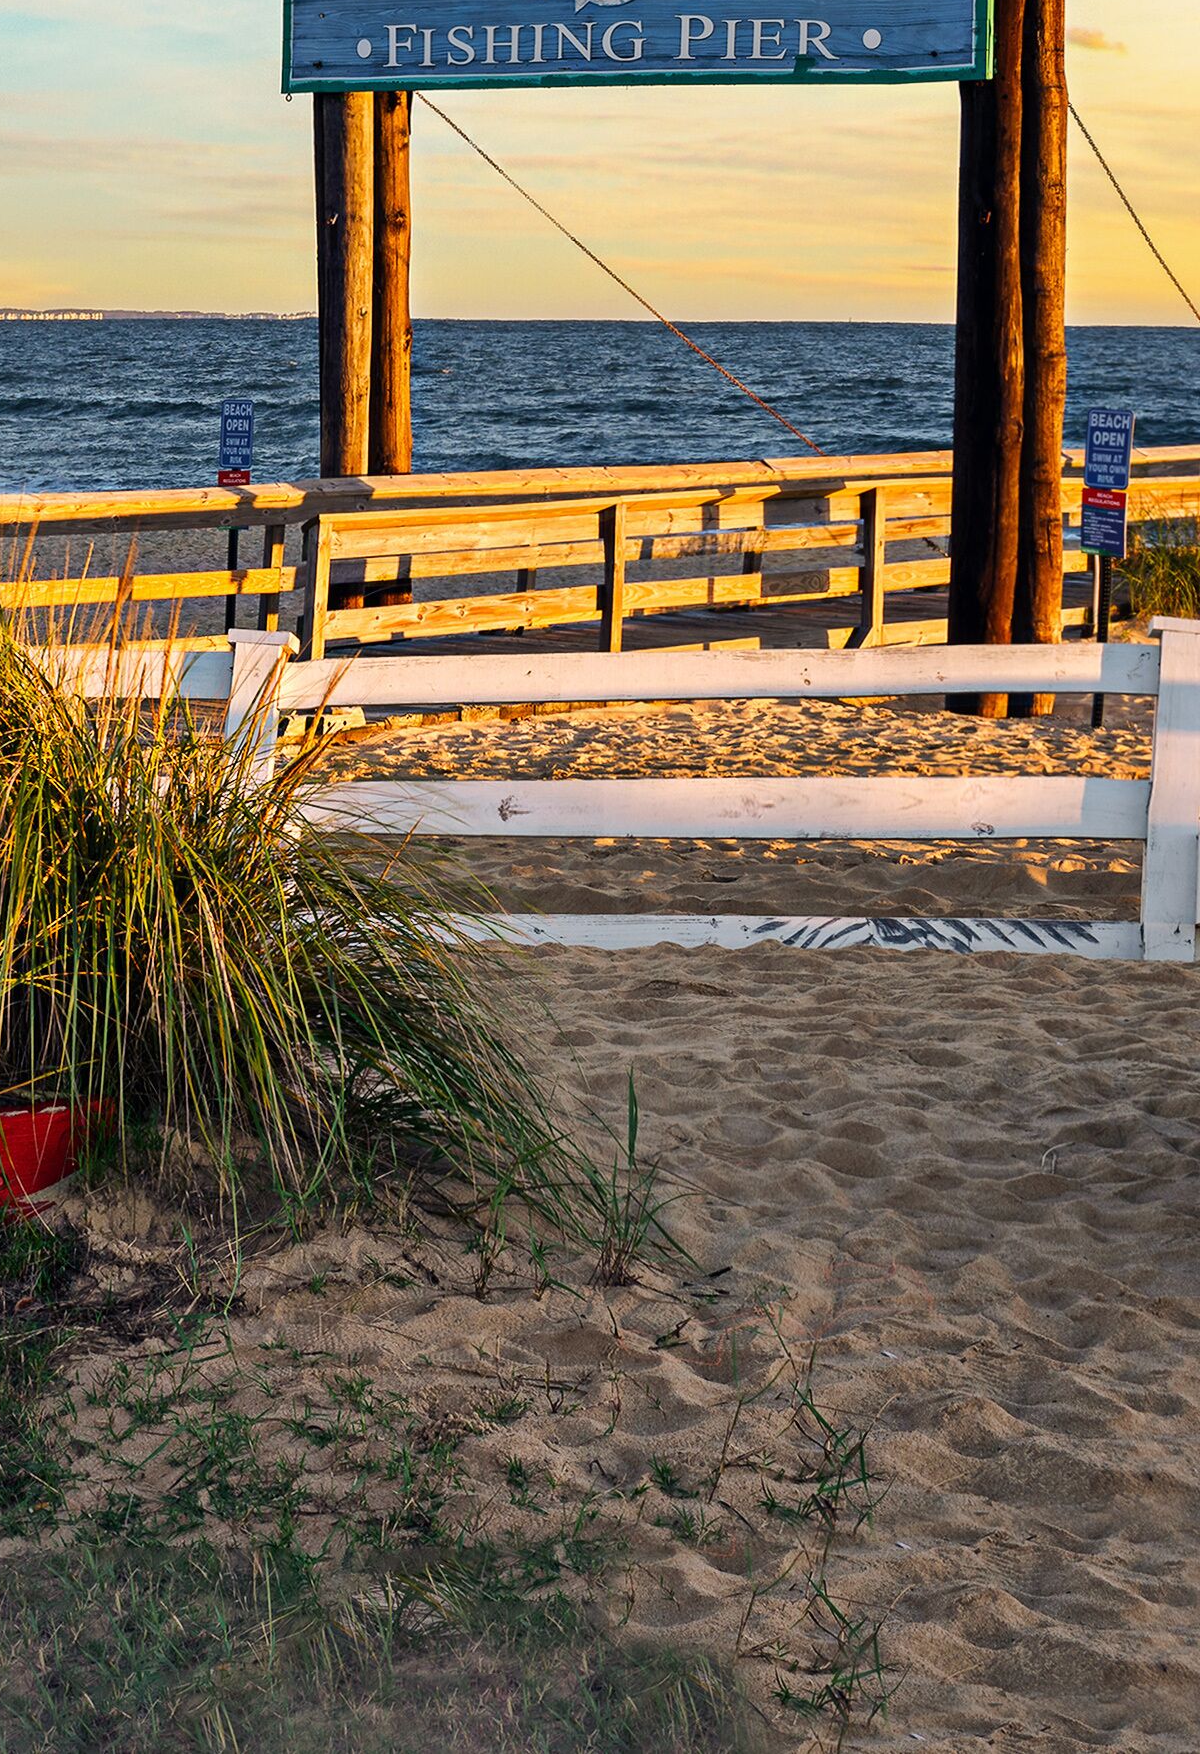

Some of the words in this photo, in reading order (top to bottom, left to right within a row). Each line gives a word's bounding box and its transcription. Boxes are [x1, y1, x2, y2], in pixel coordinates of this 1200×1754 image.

[383, 19, 644, 68] FISHING
[675, 15, 840, 61] PIER
[224, 404, 252, 416] BEACH
[226, 419, 249, 431] OPEN
[1090, 413, 1130, 429] BEACH
[1093, 431, 1125, 447] OPEN
[1092, 452, 1111, 463] SWIM
[1113, 454, 1123, 463] AT
[1088, 463, 1108, 474] YOUR
